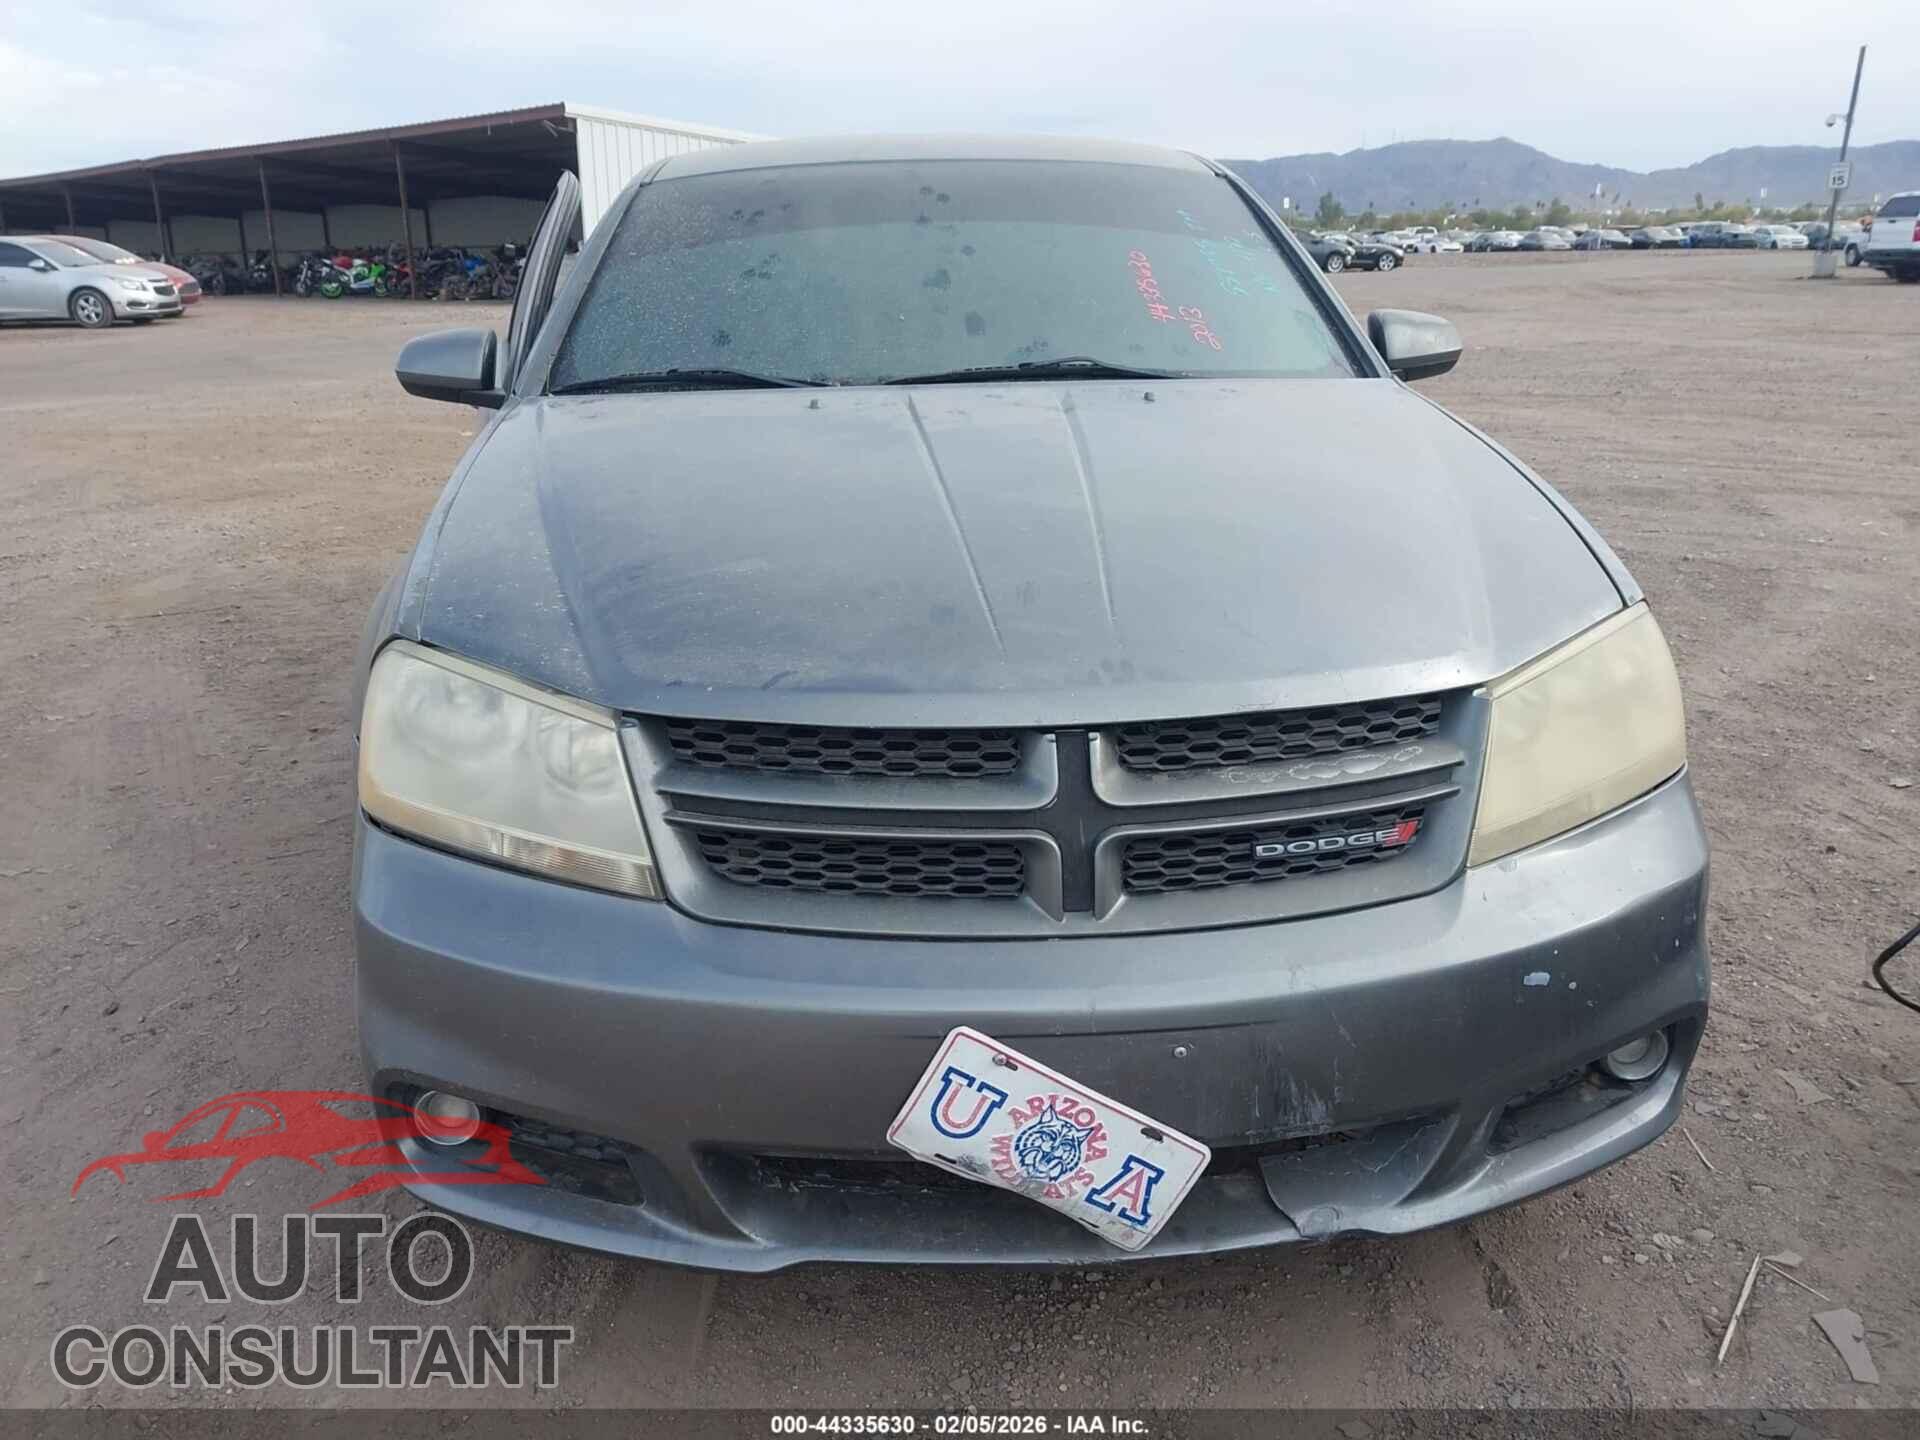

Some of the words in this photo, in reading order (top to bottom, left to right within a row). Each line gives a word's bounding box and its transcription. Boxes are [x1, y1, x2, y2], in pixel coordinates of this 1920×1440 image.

[1832, 175, 1845, 186] 15
[1255, 828, 1400, 857] DODGE
[930, 1065, 1009, 1139] U
[1085, 1154, 1165, 1226] A
[1007, 1094, 1109, 1163] ARIZONA
